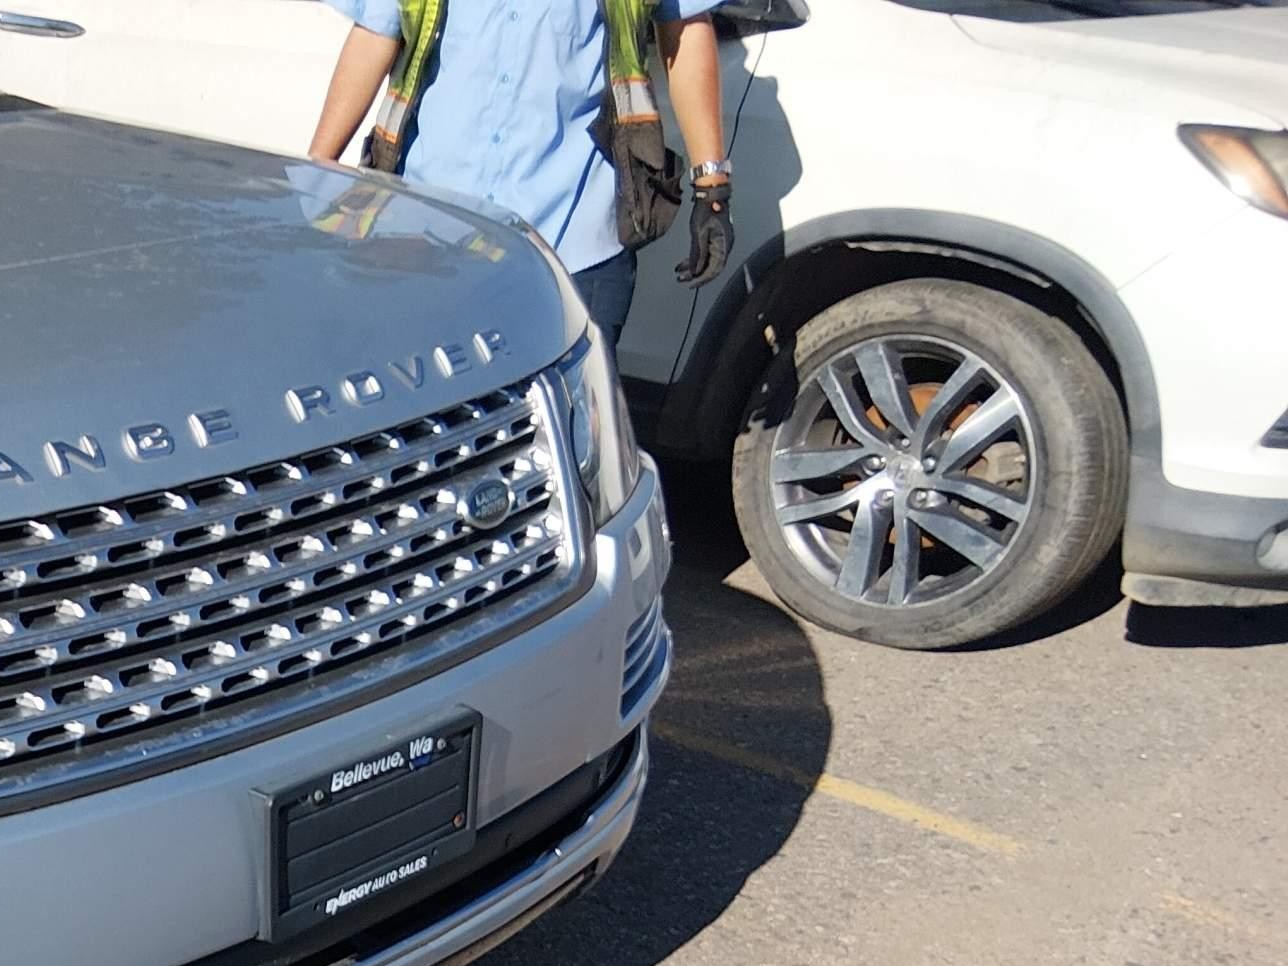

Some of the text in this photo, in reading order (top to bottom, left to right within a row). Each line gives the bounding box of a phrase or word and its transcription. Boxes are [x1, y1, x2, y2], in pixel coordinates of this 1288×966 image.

[285, 328, 511, 424] ROVER
[330, 735, 433, 792] Bellevue, Wa
[372, 869, 398, 892] AUTO
[398, 855, 428, 879] SALES
